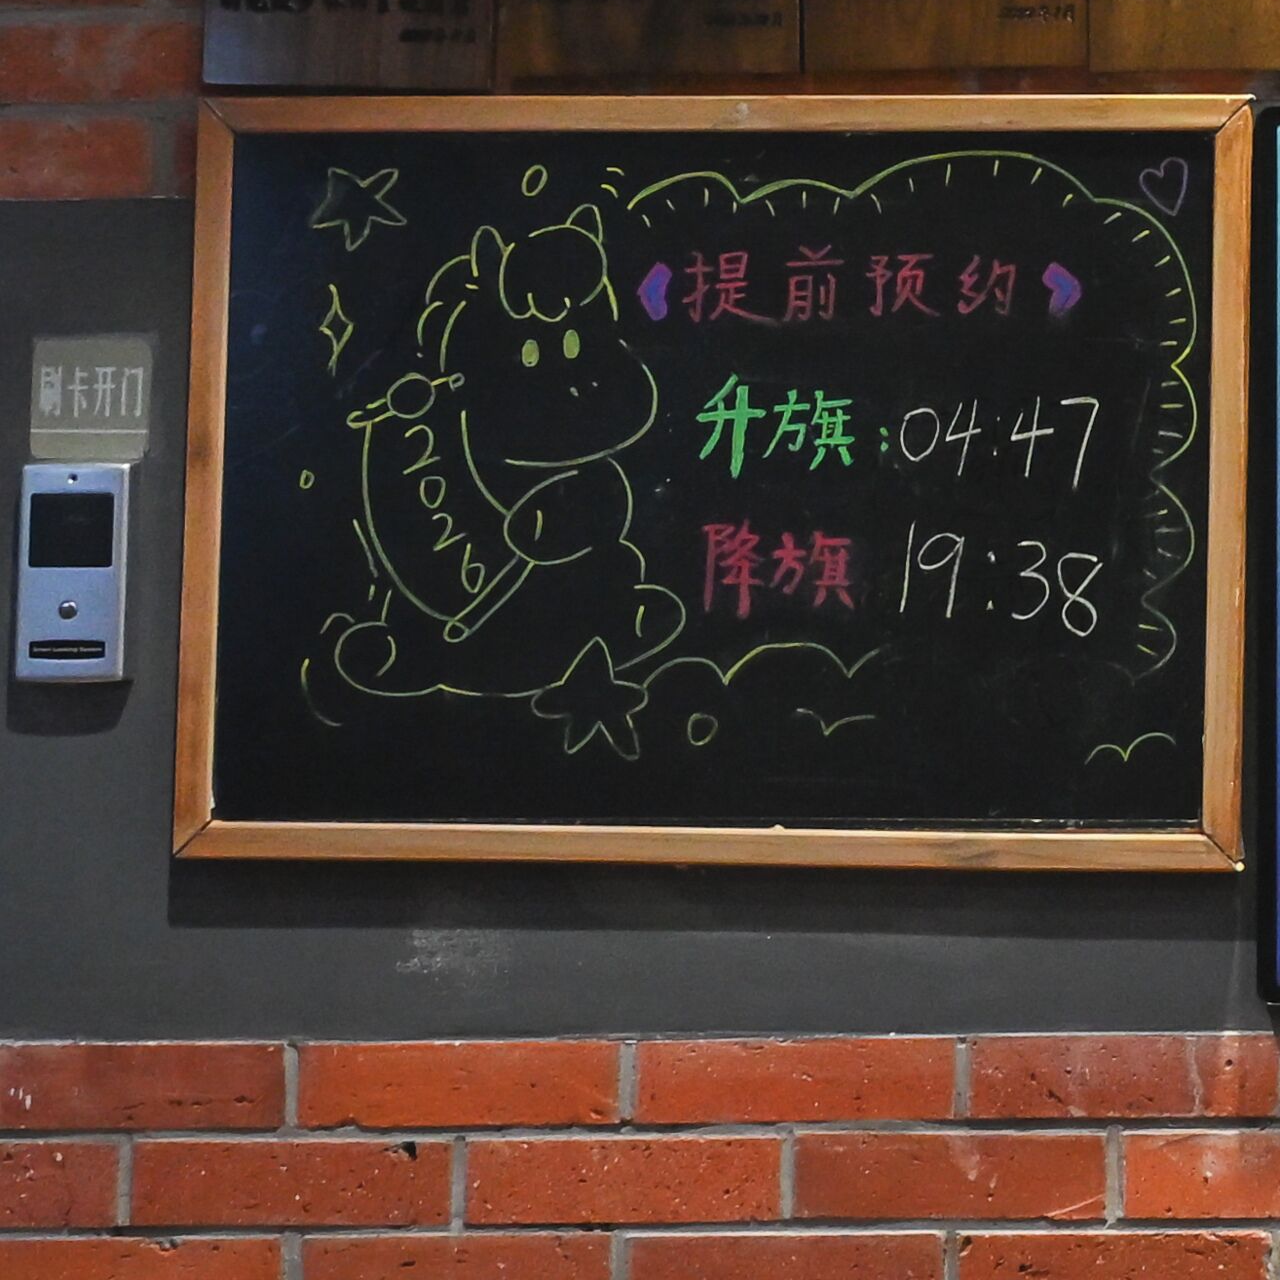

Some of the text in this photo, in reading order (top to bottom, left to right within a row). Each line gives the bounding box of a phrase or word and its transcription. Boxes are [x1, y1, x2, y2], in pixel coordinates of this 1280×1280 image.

[683, 243, 1017, 324] 提前预约
[40, 365, 145, 419] 刷卡开门
[701, 519, 1103, 639] 降旗 19:38
